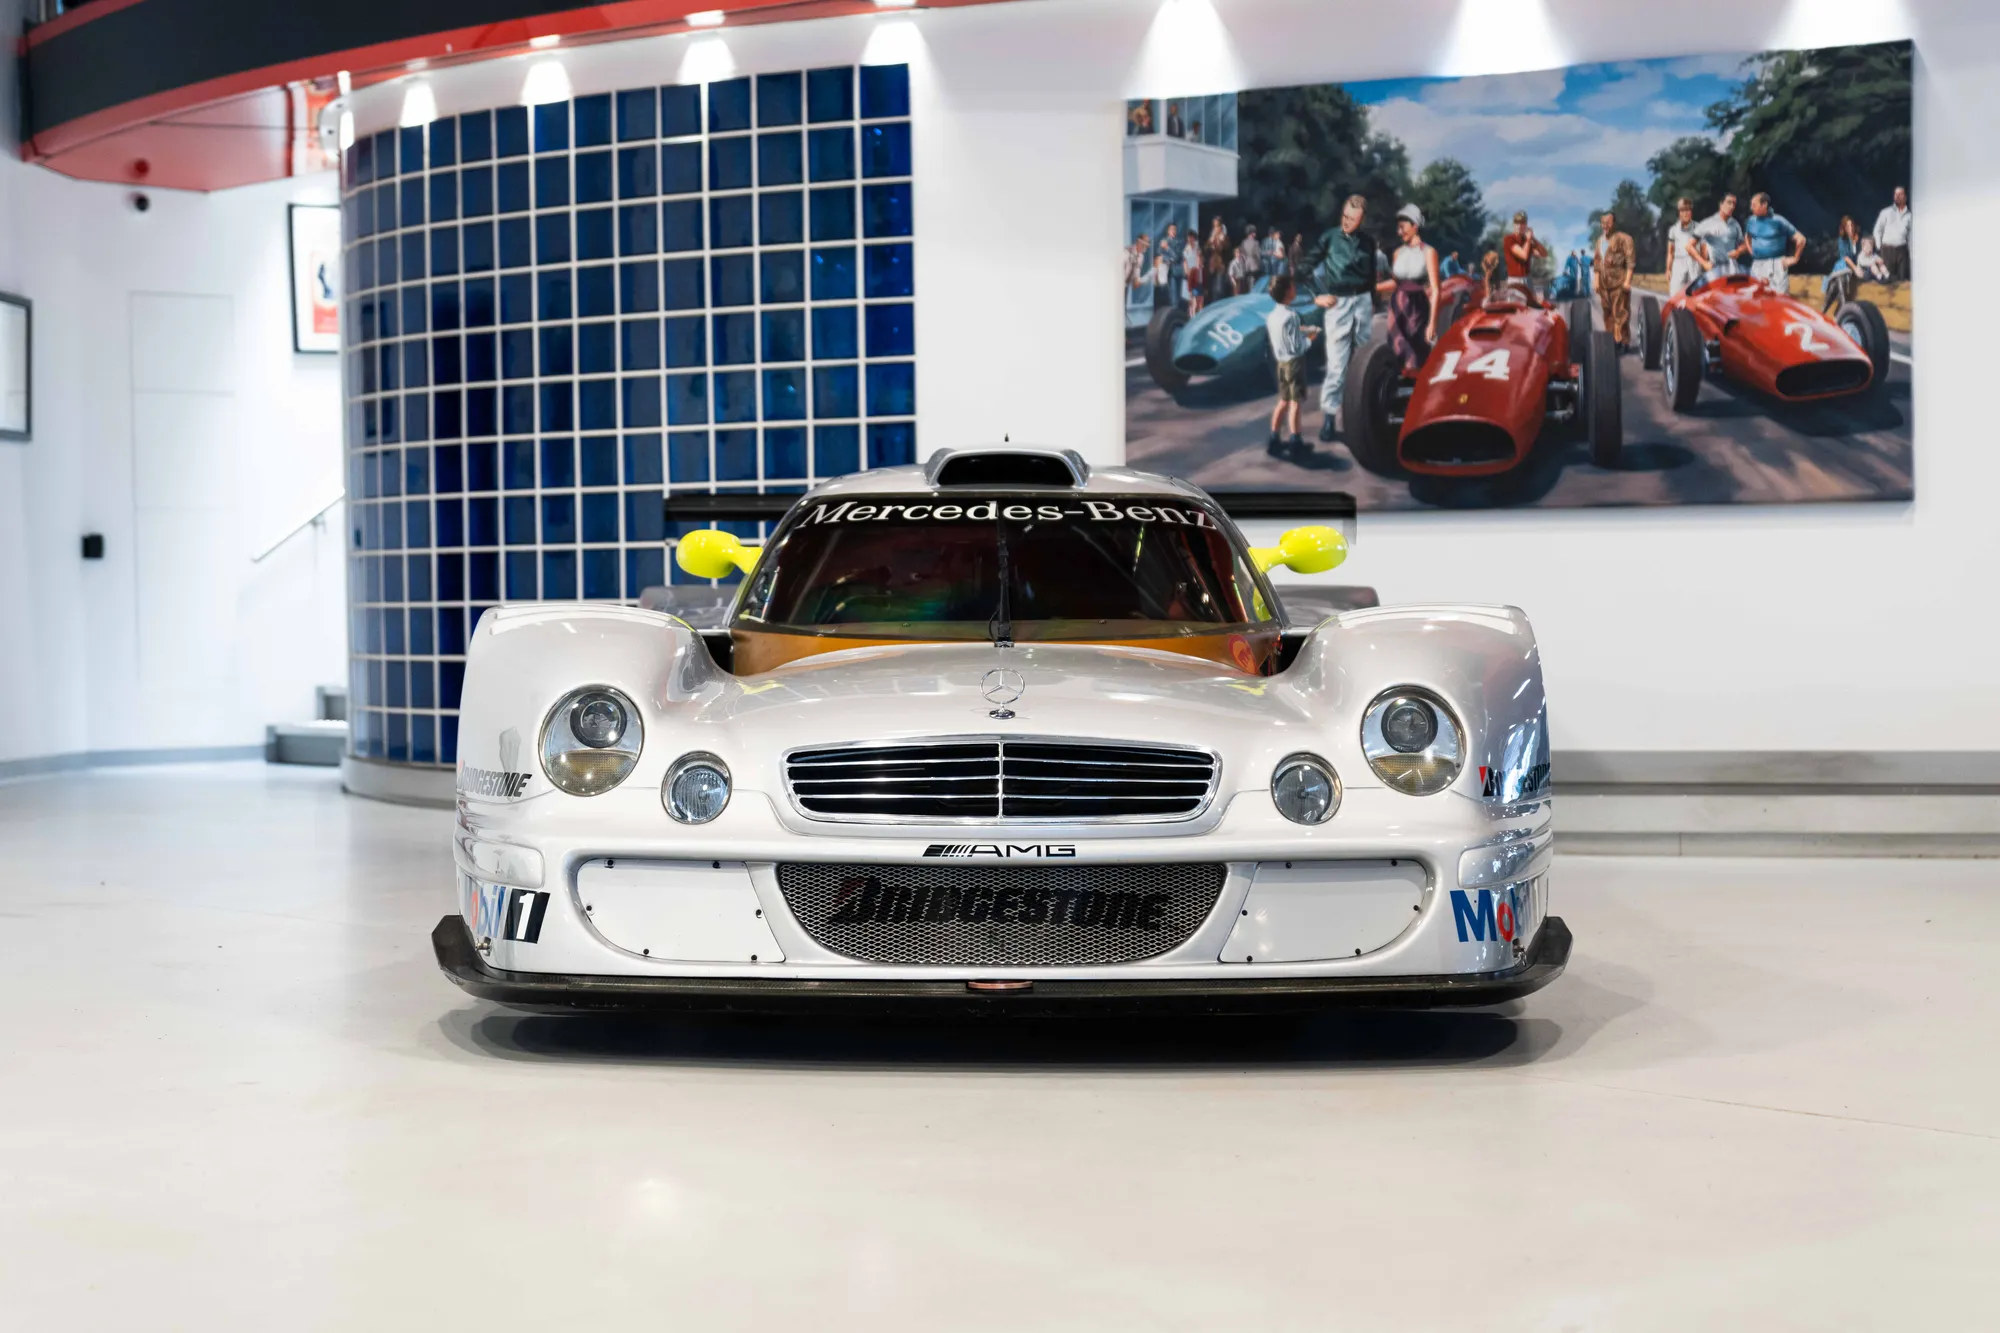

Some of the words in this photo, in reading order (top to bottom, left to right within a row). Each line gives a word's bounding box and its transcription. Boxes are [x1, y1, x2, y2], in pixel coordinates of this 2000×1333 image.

[1208, 321, 1244, 350] 18
[1784, 322, 1829, 352] 2
[1429, 349, 1510, 384] 14
[795, 500, 1217, 530] Mercedes-Benz
[827, 876, 1172, 931] BRIDGESTONE
